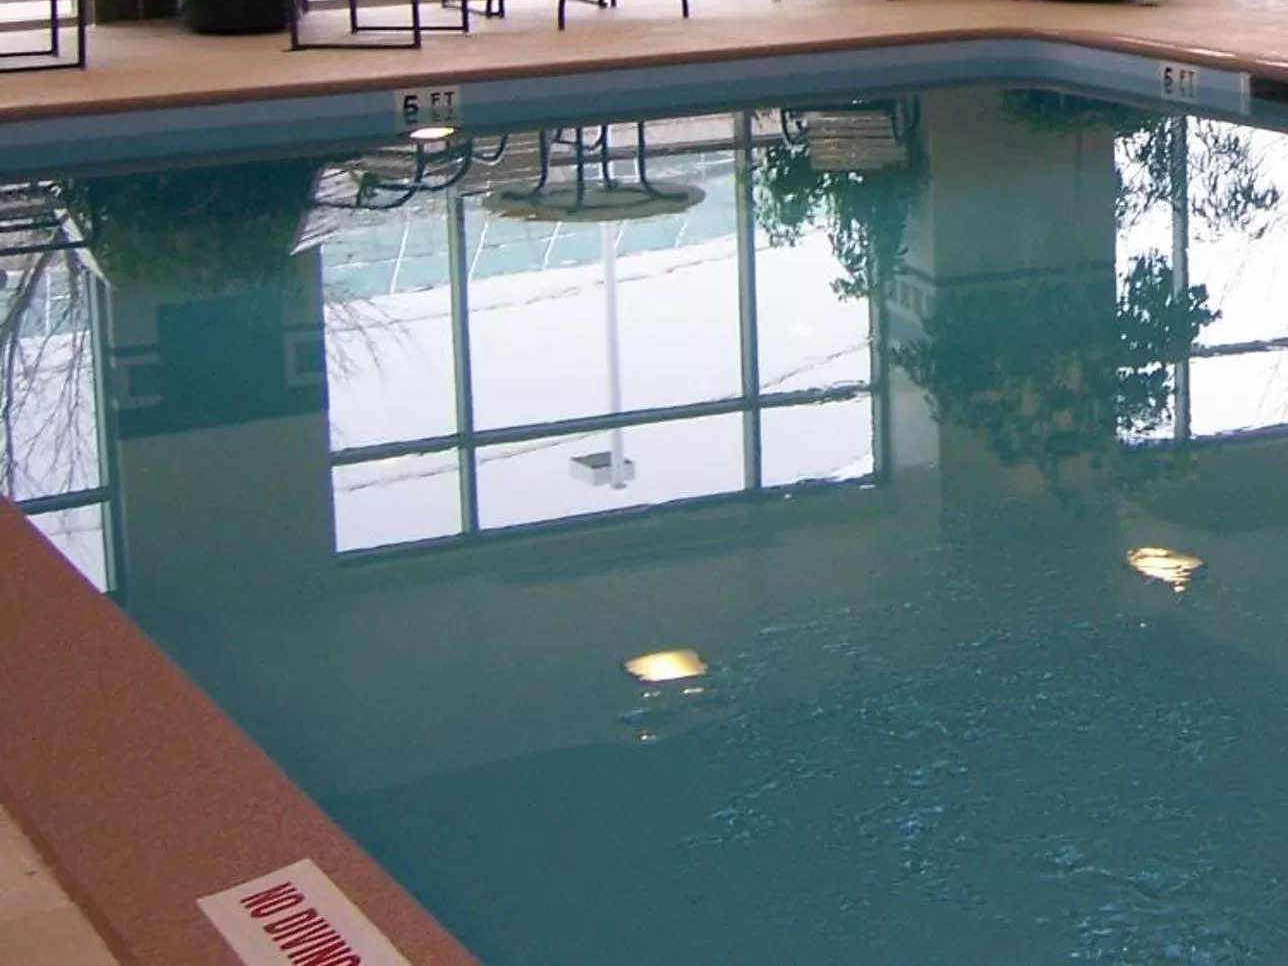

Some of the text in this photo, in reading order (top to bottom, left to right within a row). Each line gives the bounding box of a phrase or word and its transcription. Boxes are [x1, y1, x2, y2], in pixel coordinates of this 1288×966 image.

[402, 91, 455, 115] 5 FT
[240, 881, 305, 919] NO
